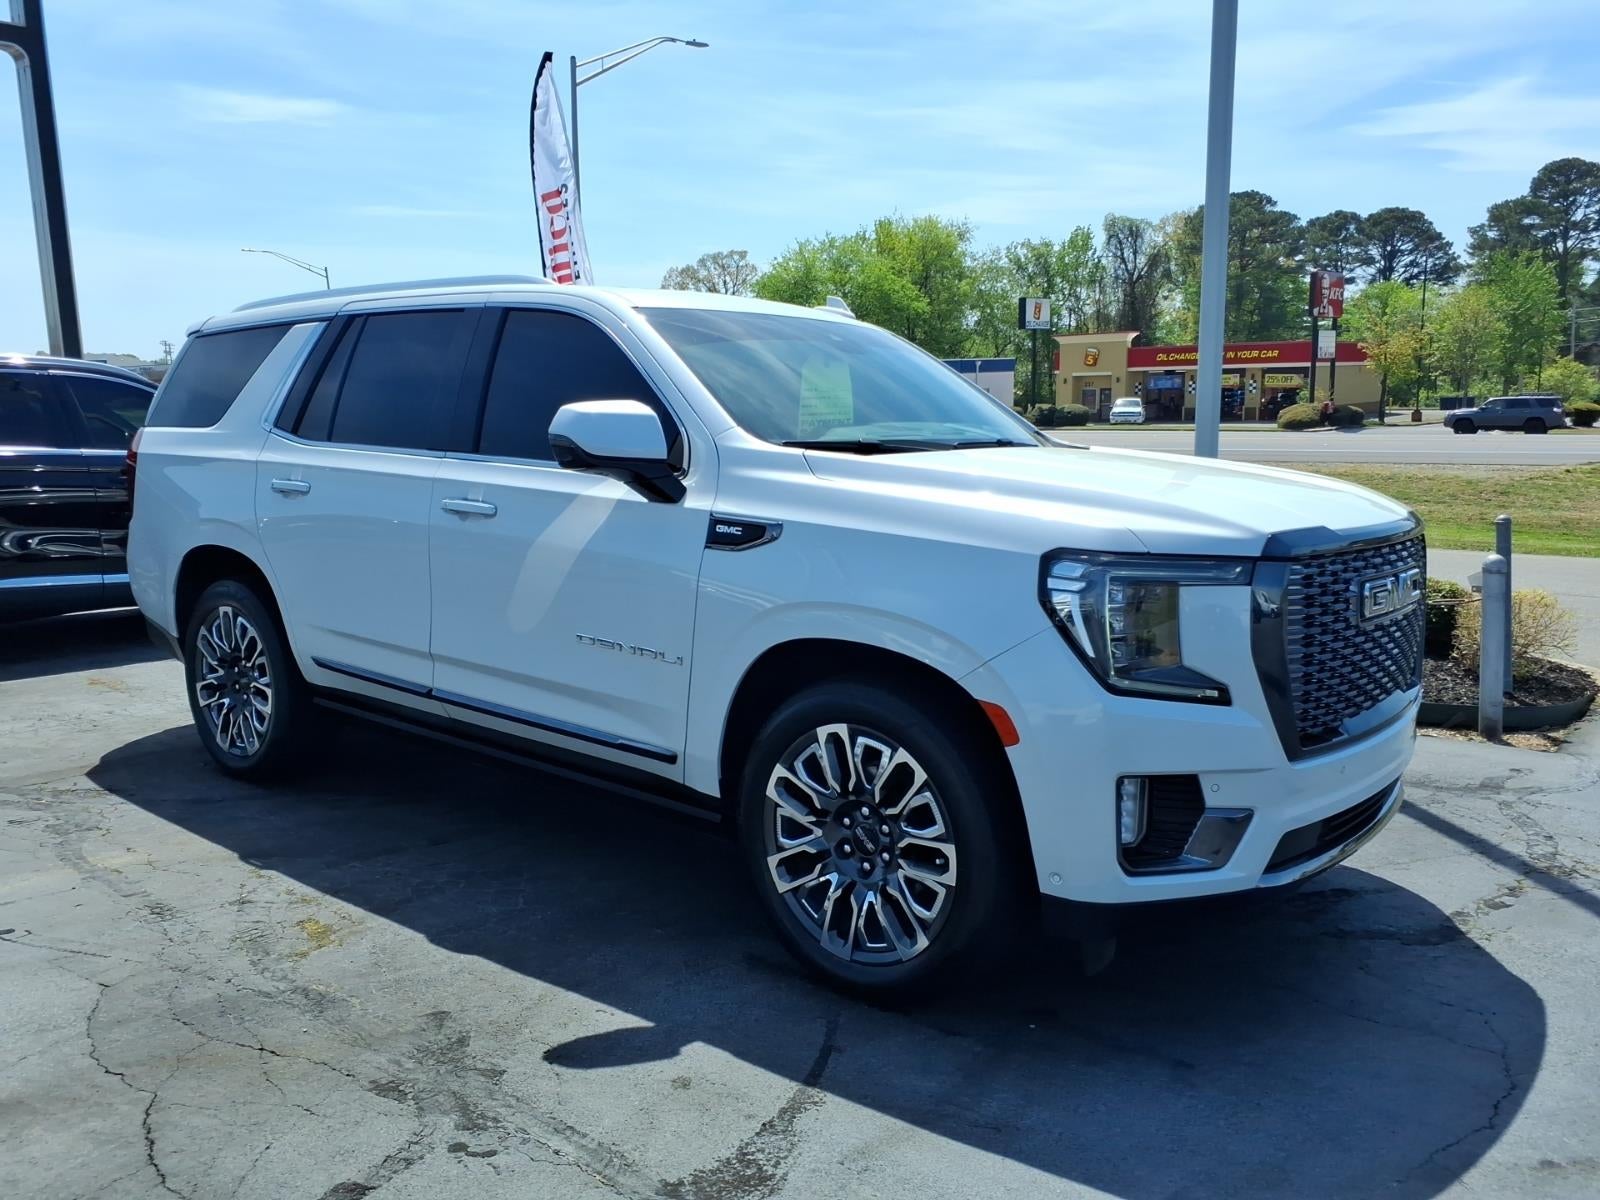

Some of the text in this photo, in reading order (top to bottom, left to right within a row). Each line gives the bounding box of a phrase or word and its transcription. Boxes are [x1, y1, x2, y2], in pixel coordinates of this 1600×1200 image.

[1329, 287, 1344, 300] KFC
[1086, 355, 1095, 365] 5
[1156, 353, 1168, 361] OIL
[1226, 351, 1236, 359] IN
[1237, 350, 1260, 359] YOUR
[1260, 350, 1280, 358] CAR
[1266, 375, 1295, 384] 25% OFF
[715, 524, 743, 535] GMC
[1364, 568, 1421, 618] GMC
[576, 632, 684, 667] DENALI
